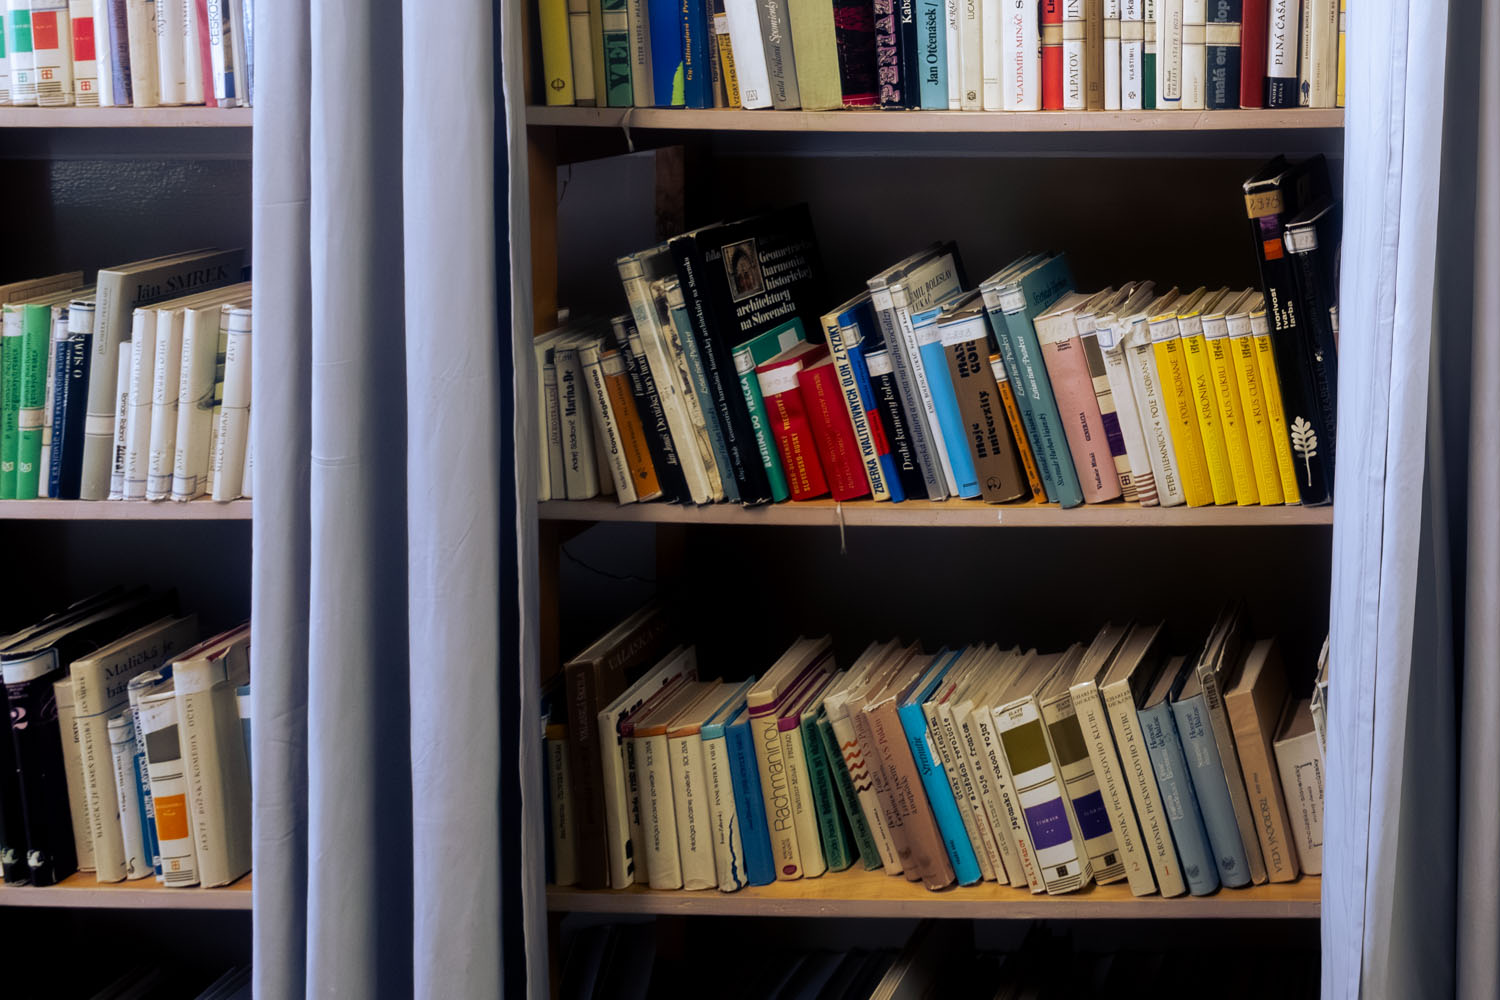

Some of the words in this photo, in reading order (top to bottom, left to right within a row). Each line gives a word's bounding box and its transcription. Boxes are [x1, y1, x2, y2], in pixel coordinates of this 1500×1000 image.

[1274, 0, 1286, 30] ČAŠA
[924, 9, 937, 64] Otčenášek
[1274, 34, 1285, 65] PLNÁ
[926, 66, 939, 85] Jan
[1015, 51, 1023, 104] VLADIMÍR
[1214, 68, 1226, 103] malá
[1287, 301, 1296, 327] farba
[828, 325, 844, 353] FYZIKY
[840, 364, 856, 386] ÚLOH
[1197, 374, 1212, 419] KRONIKA
[848, 389, 874, 456] KVALITATÍVNYCH
[890, 401, 905, 440] kameny
[978, 391, 1000, 455] univerzity
[897, 441, 913, 471] Drahé
[971, 423, 987, 458] Moje
[867, 458, 884, 495] ZBIERKA
[1086, 710, 1101, 739] KLUBU
[1119, 712, 1134, 741] KLUBU
[763, 721, 793, 832] Rachmaninov
[1118, 812, 1135, 853] KRONIKA
[1149, 816, 1166, 857] KRONIKA
